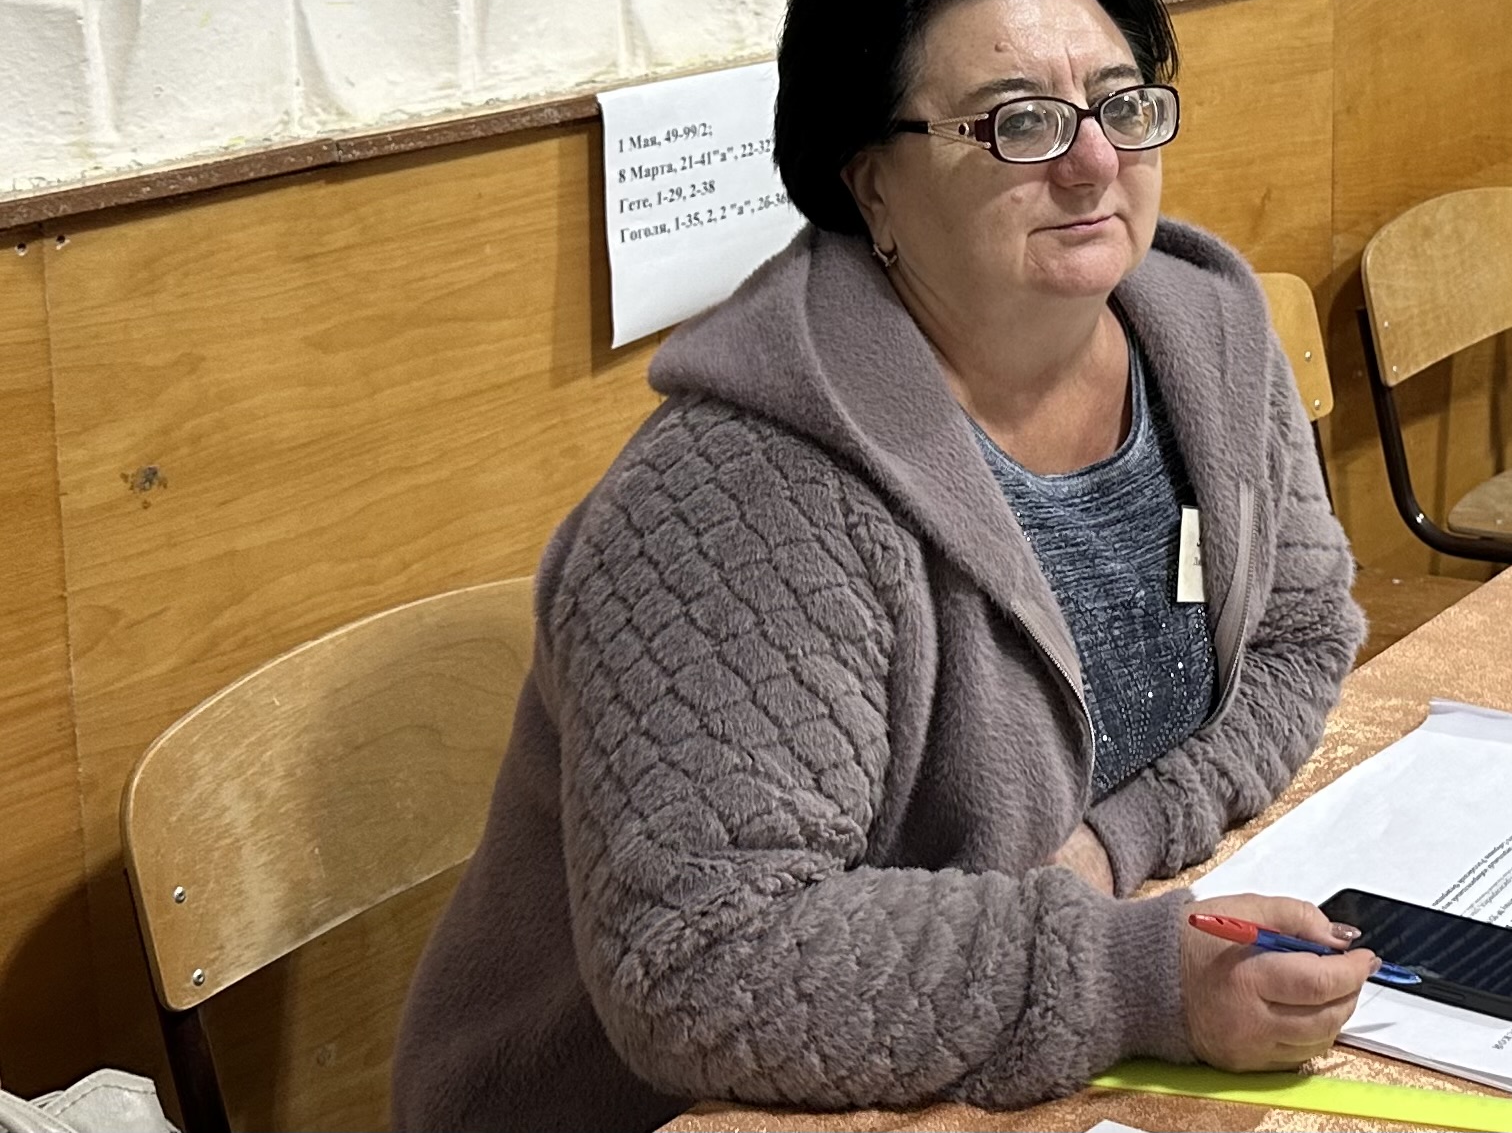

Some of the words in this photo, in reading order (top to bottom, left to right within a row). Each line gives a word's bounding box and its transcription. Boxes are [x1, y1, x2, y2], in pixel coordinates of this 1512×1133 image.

[618, 138, 624, 153] 1
[629, 133, 661, 151] Мая,
[664, 123, 713, 142] 49-99/2;
[618, 168, 626, 183] 8
[630, 162, 678, 182] Марта,
[681, 147, 738, 171] 21-41"а",
[741, 139, 771, 158] 22-32
[619, 198, 652, 213] Гете,
[656, 186, 686, 206] 1-29,
[689, 180, 715, 199] 2-38
[620, 223, 670, 243] Гоголя,
[674, 211, 703, 231] 1-35,
[707, 208, 717, 224] 2,
[720, 205, 727, 220] 2
